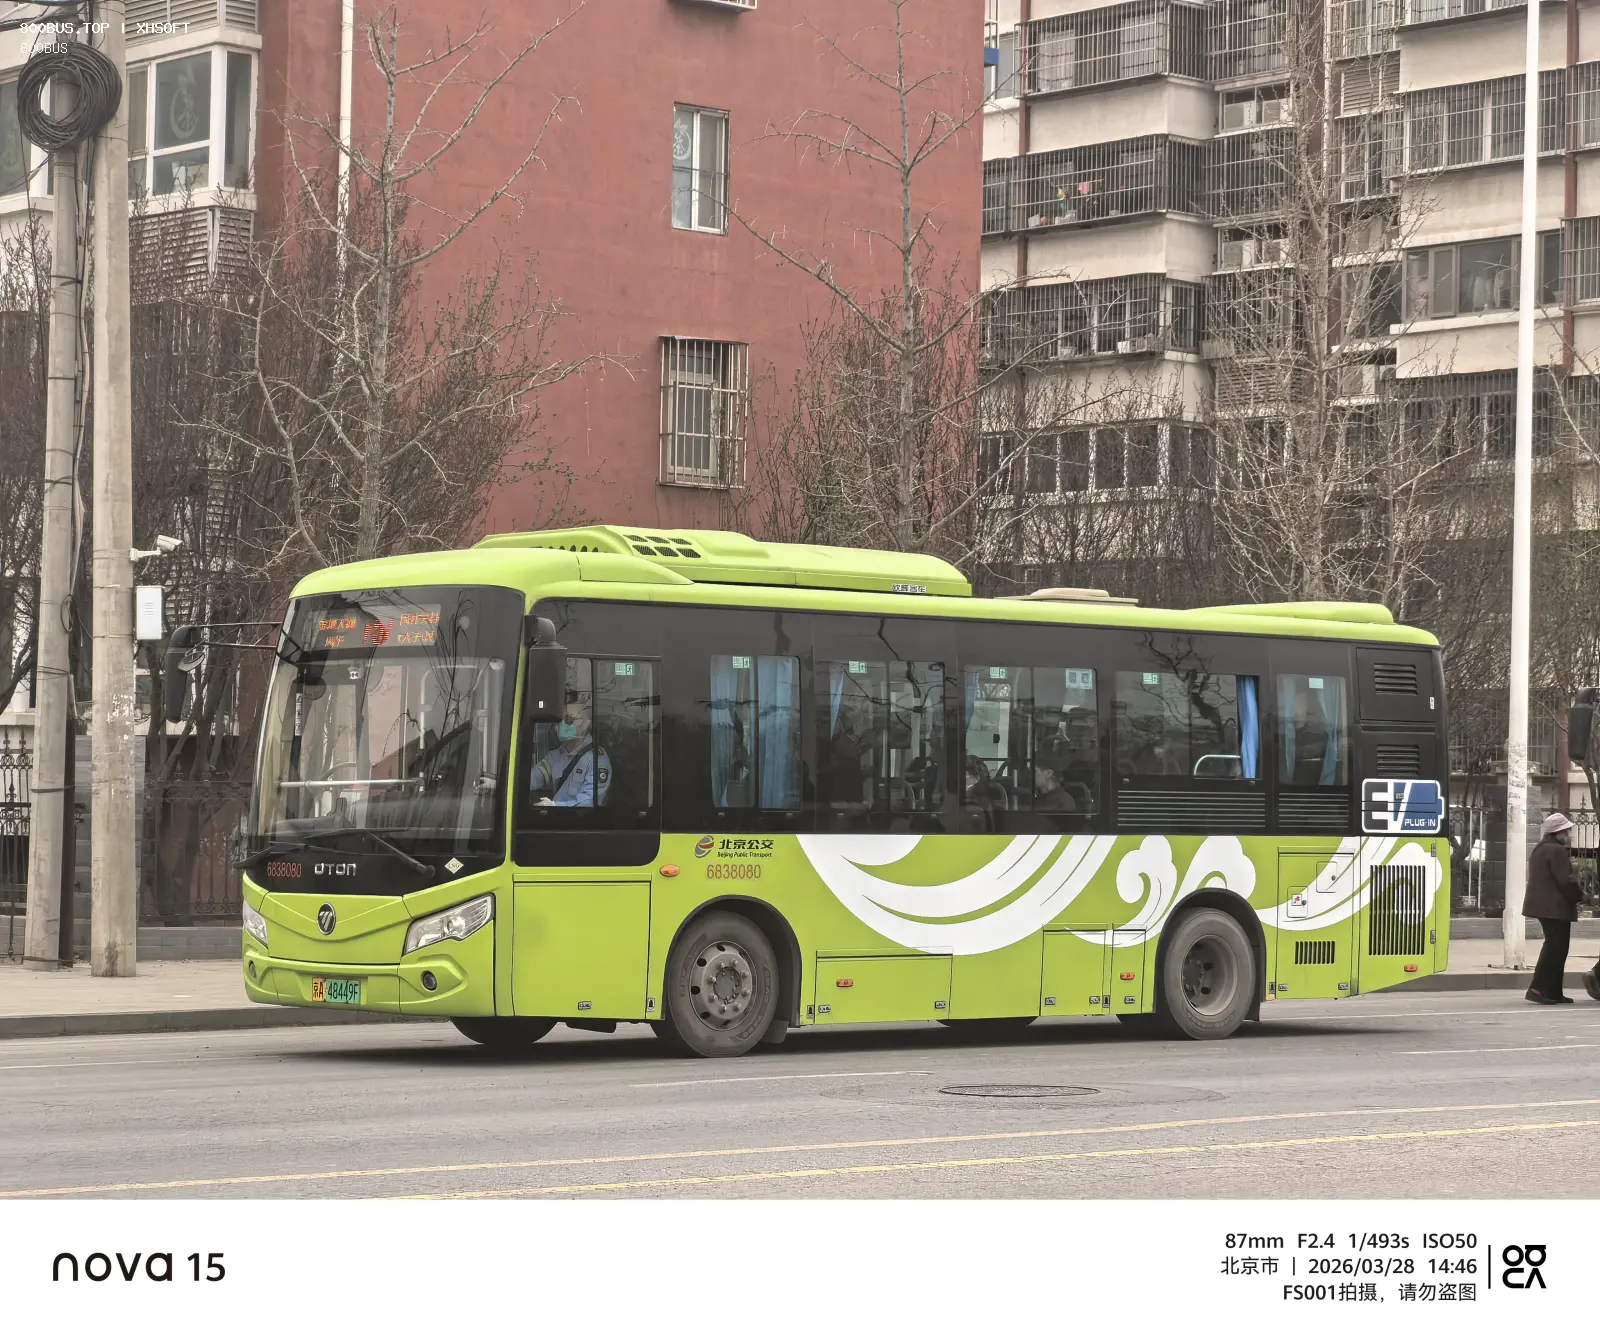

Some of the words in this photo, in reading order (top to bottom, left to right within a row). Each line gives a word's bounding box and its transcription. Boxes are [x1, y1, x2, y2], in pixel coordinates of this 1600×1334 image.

[1364, 781, 1412, 831] EV
[1404, 818, 1436, 827] PLUG-IN
[719, 839, 774, 850] 北京公交
[267, 862, 302, 878] 6838080
[706, 864, 761, 879] 6838080
